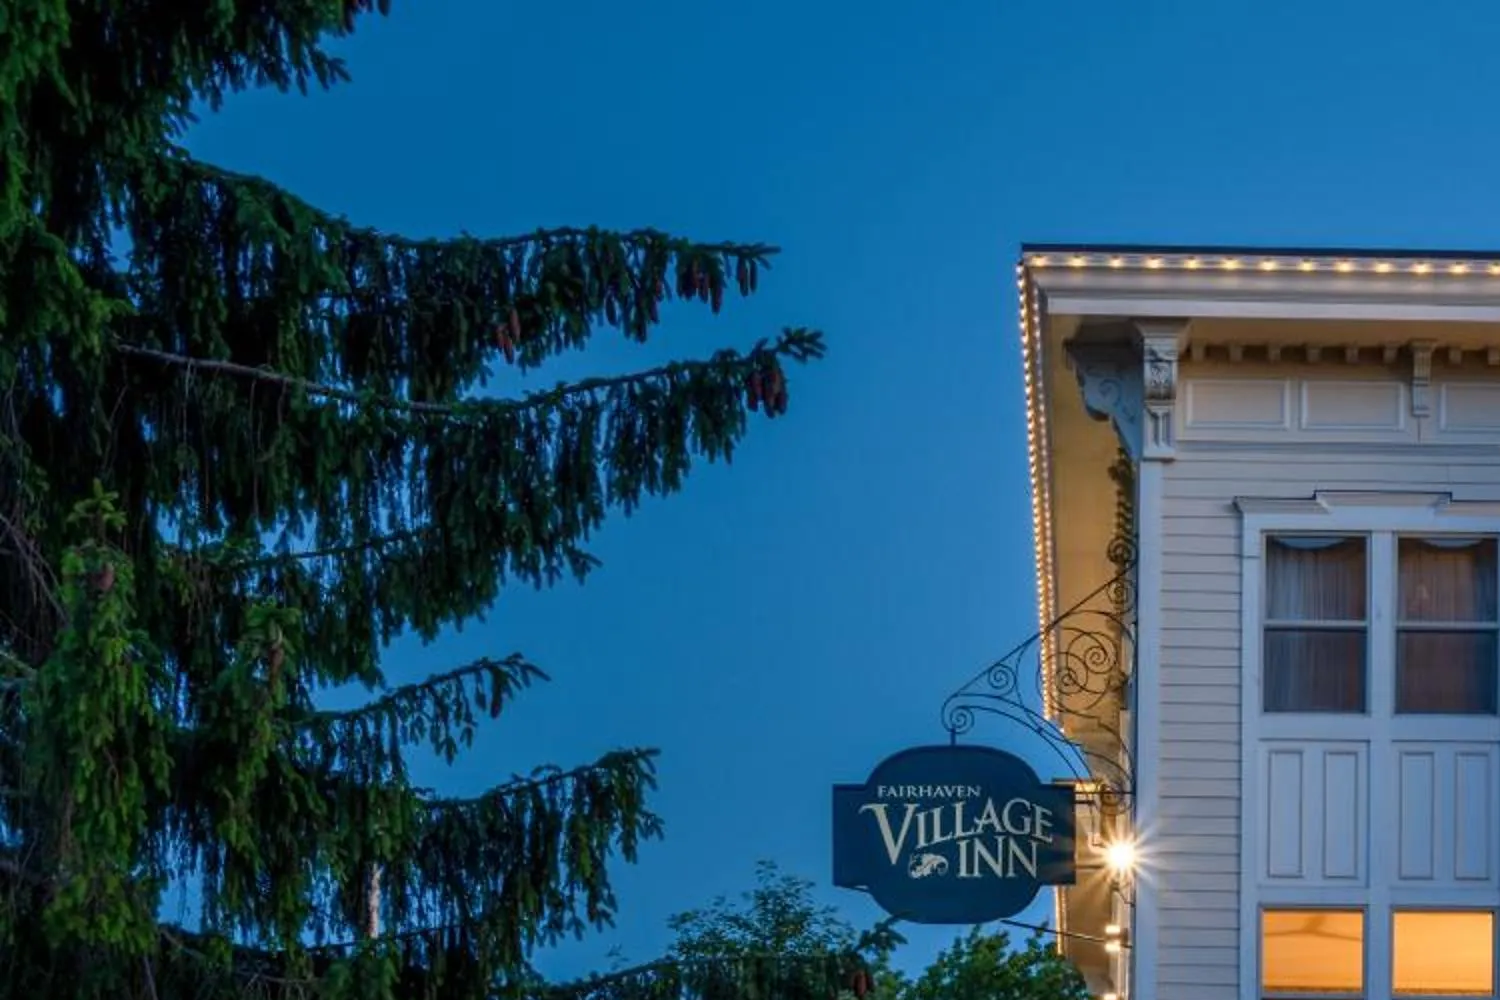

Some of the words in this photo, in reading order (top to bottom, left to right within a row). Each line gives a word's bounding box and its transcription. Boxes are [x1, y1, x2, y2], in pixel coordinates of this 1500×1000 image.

[877, 783, 982, 799] FAIRHAVEN
[858, 797, 1054, 866] VILLAGE
[956, 835, 1044, 879] INN
